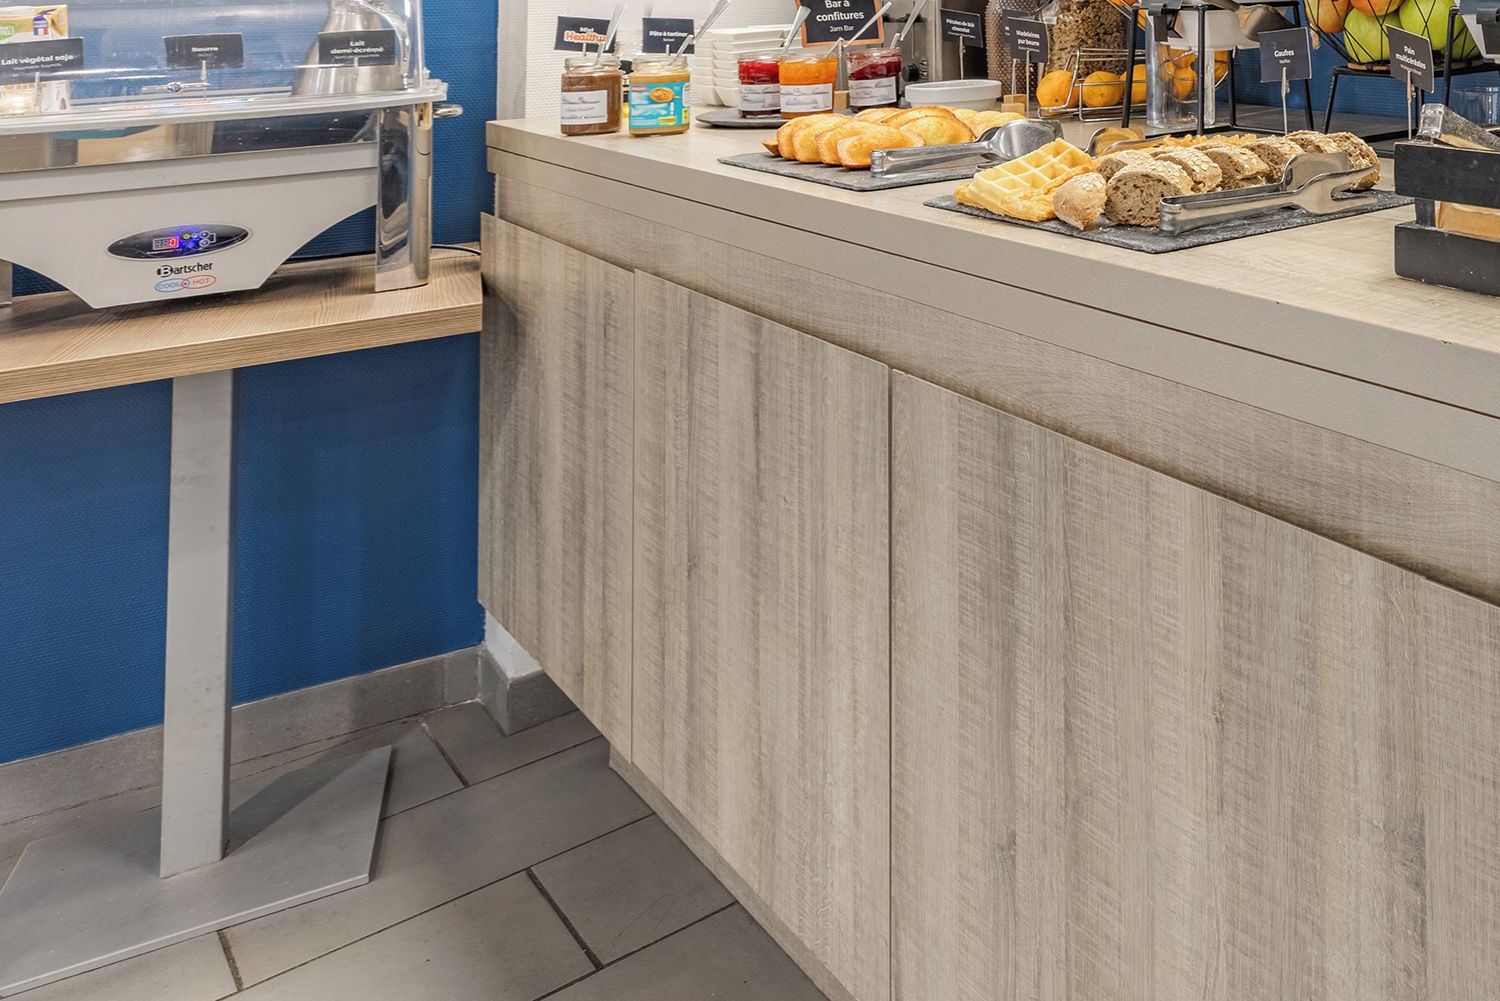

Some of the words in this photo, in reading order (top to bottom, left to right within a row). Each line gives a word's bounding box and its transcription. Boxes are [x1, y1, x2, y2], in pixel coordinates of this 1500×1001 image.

[816, 11, 865, 22] confitures
[829, 25, 843, 33] Jam
[843, 24, 854, 32] Bar
[1016, 30, 1040, 39] Madeleines
[1274, 48, 1295, 58] Gaufres
[1403, 45, 1416, 56] Pain
[1, 58, 19, 66] Lait
[19, 55, 54, 65] végétal
[157, 262, 213, 278] Bartscher
